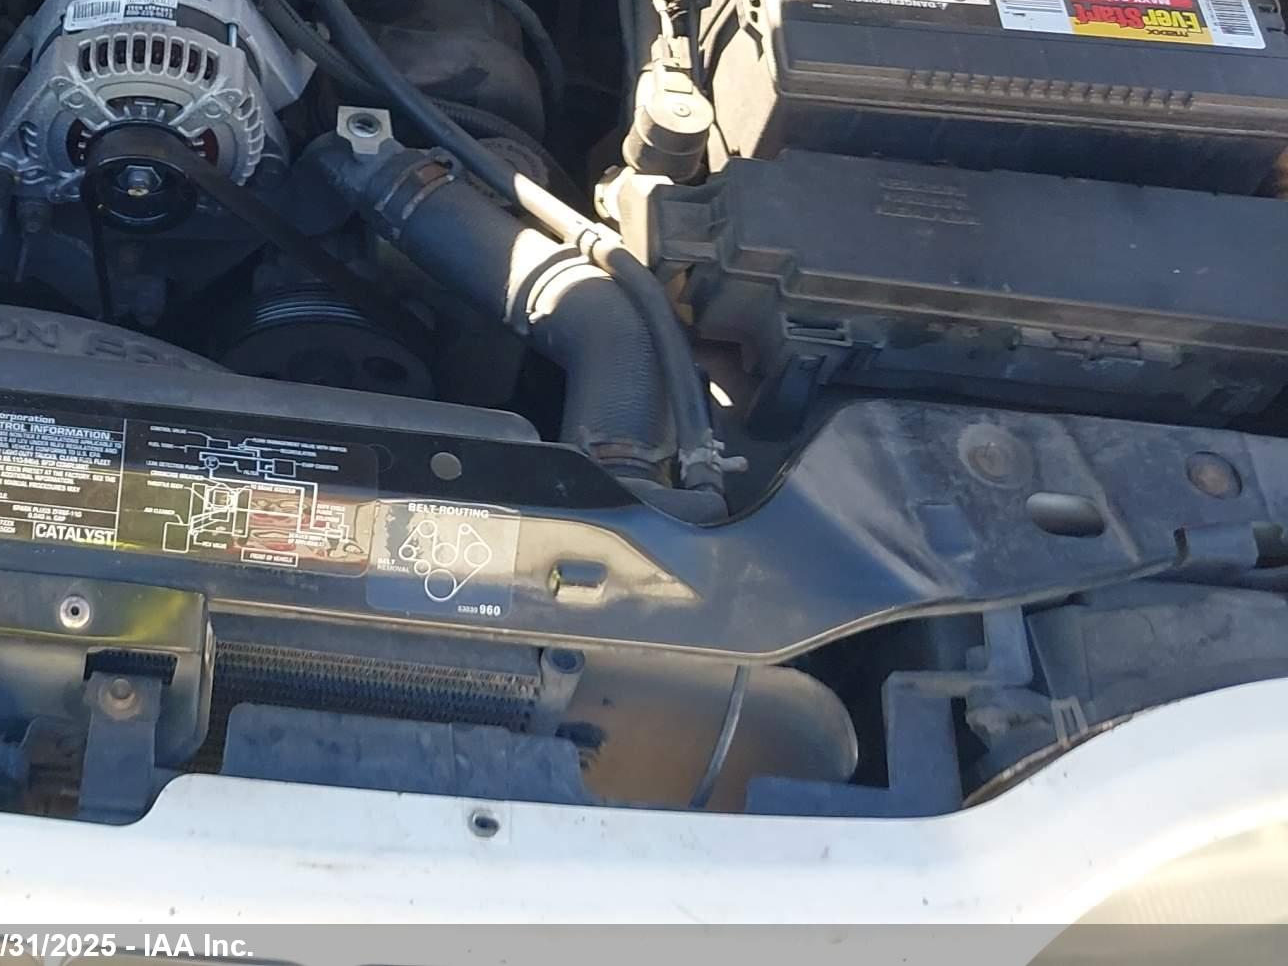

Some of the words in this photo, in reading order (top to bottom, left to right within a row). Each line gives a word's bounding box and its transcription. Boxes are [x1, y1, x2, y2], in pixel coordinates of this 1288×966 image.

[1072, 4, 1203, 35] EverStart
[408, 503, 435, 514] BELT
[439, 505, 489, 519] ROUTING
[34, 523, 112, 545] CATALYST
[480, 604, 501, 616] 960
